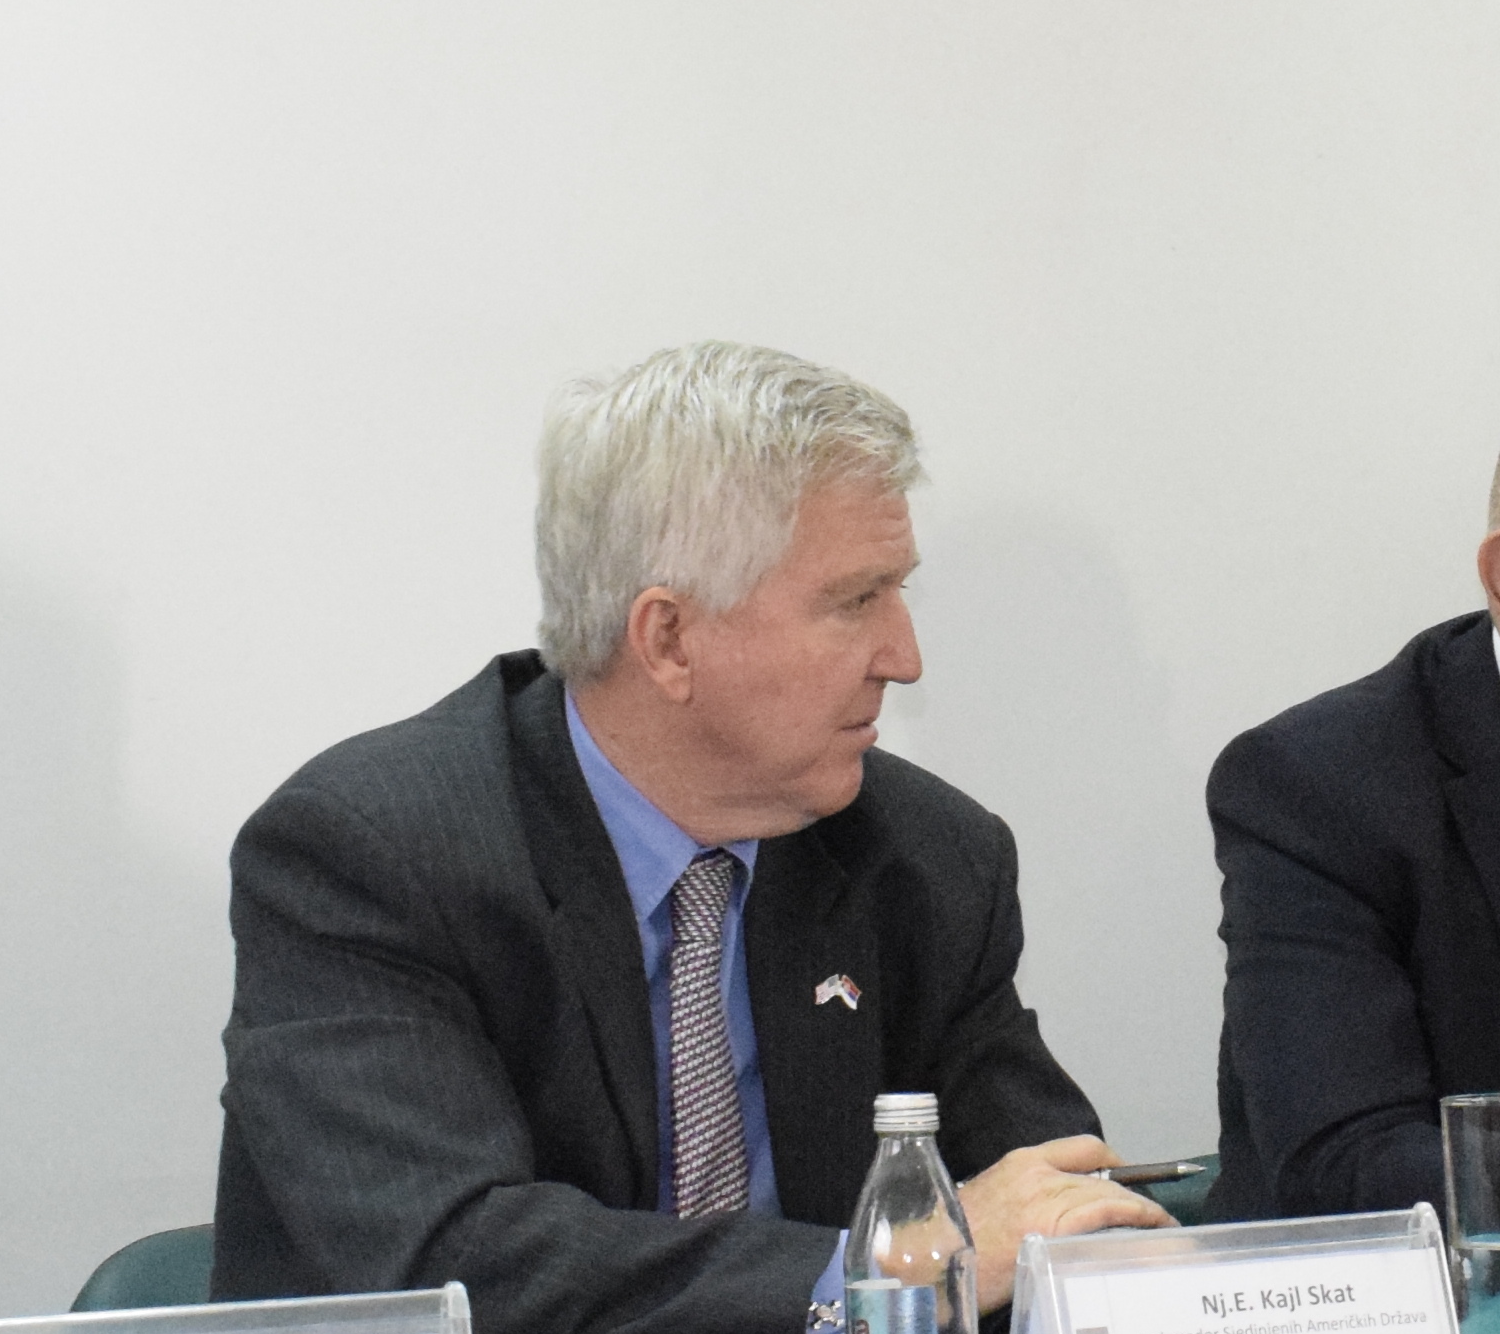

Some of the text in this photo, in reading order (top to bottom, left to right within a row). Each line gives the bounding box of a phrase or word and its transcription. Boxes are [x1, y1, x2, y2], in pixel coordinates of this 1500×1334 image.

[1201, 1282, 1355, 1319] Nj.E. Kajl Skat
[1306, 1313, 1377, 1334] Američkih
[1380, 1307, 1427, 1327] Država
